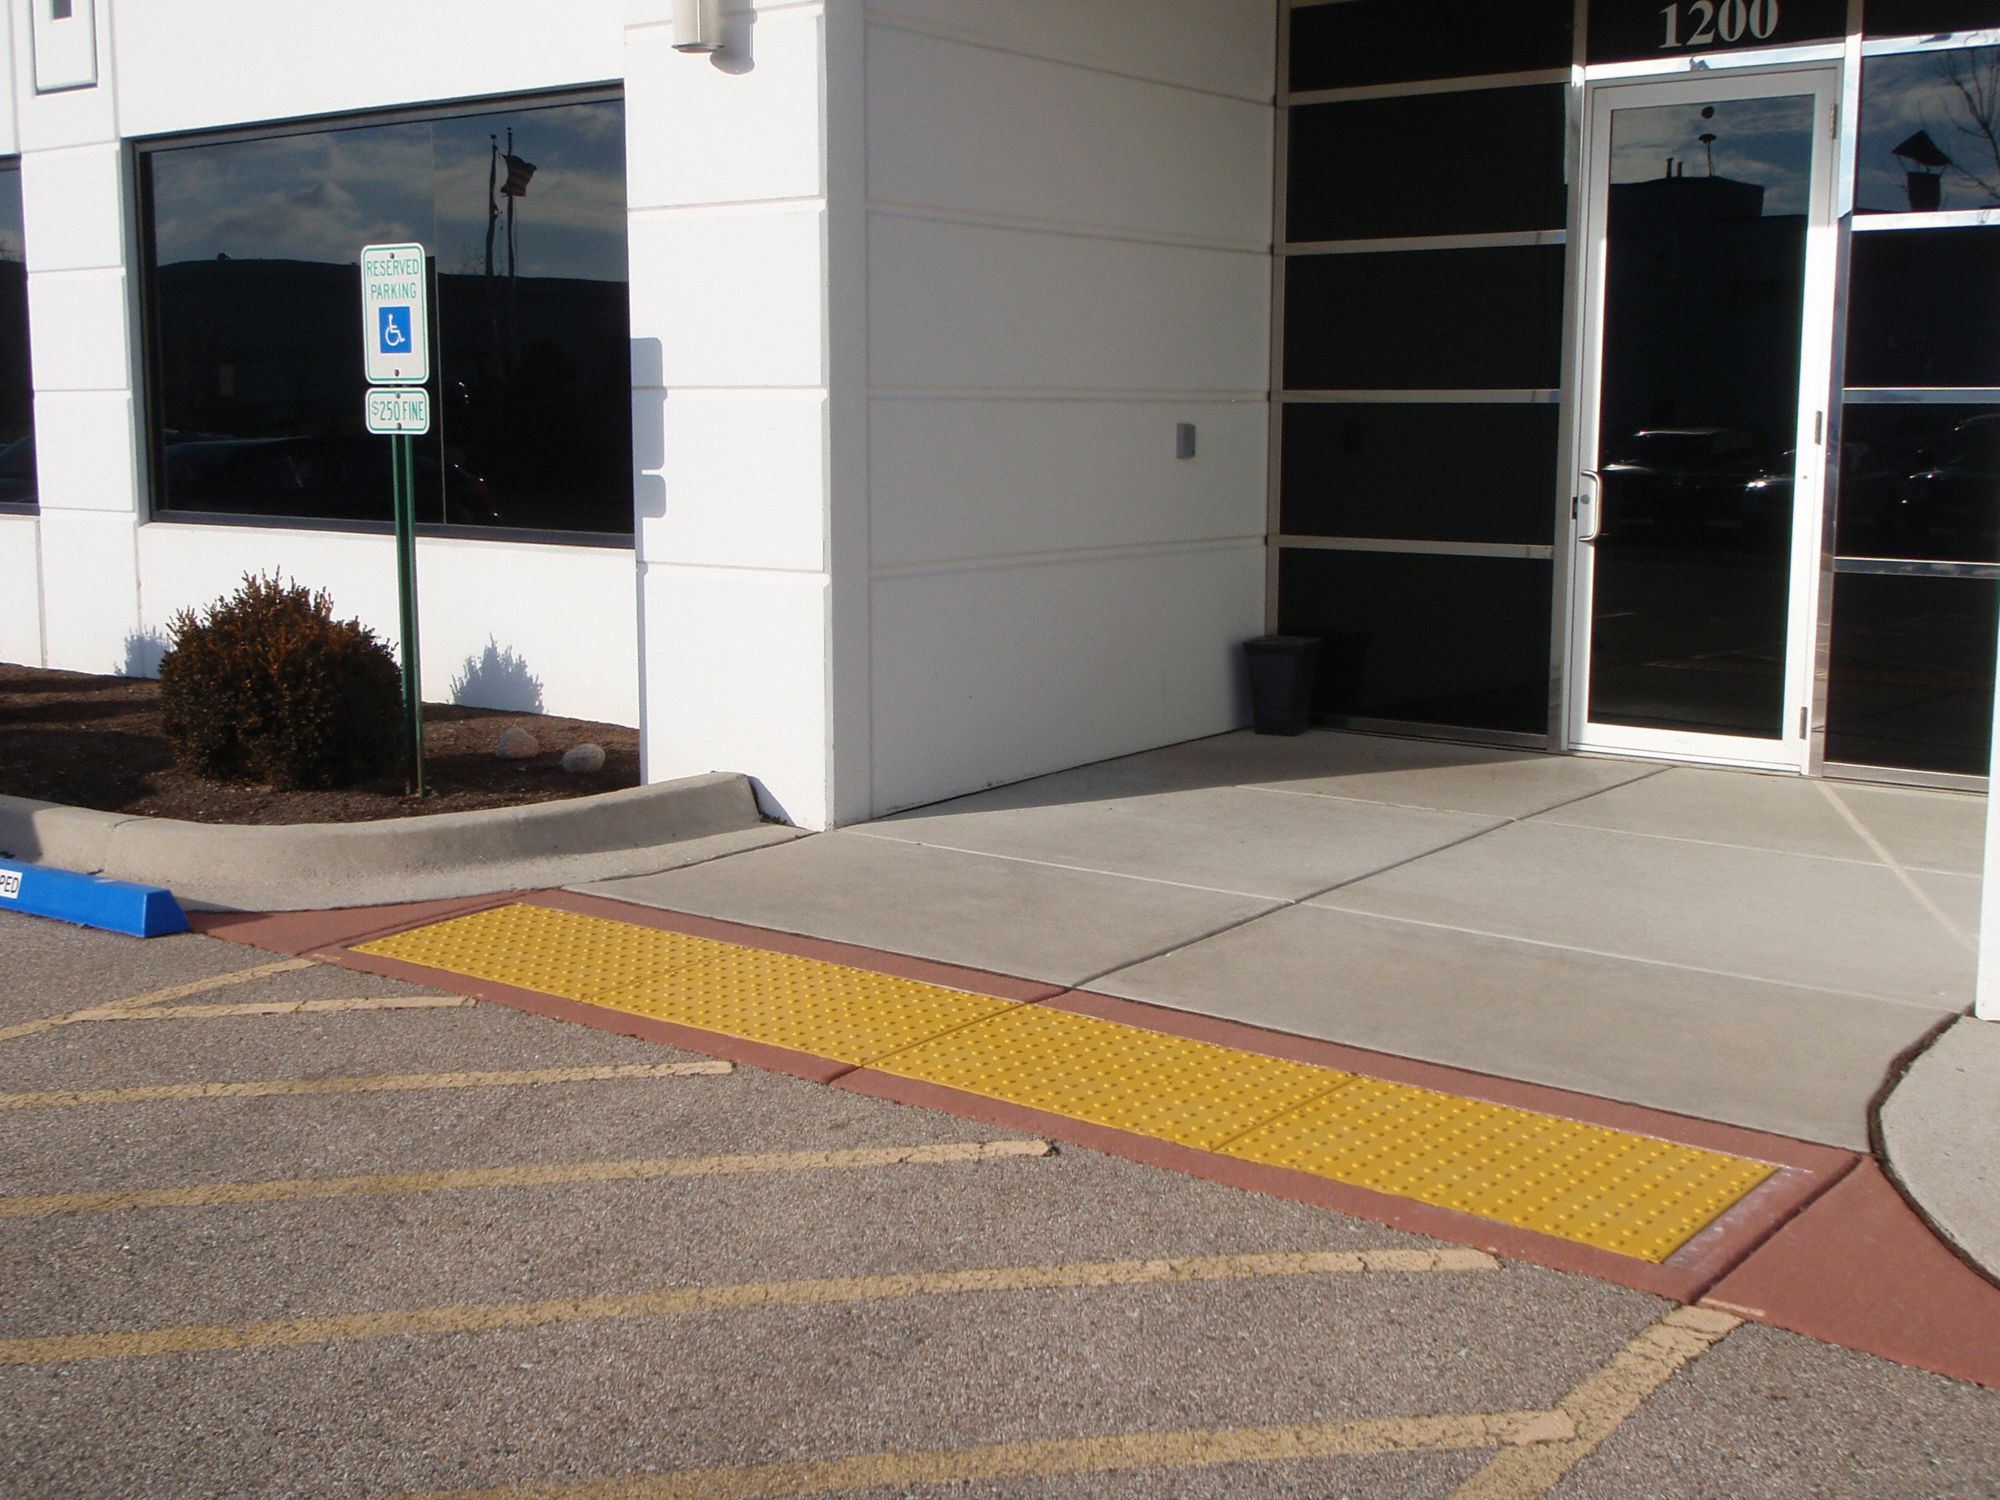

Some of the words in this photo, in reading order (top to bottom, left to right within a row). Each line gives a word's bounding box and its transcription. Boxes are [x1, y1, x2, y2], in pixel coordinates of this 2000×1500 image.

[1659, 0, 1778, 48] 1200
[366, 259, 419, 277] RESERVED
[371, 283, 417, 300] PARKING
[371, 401, 400, 421] $250
[402, 401, 424, 421] FINE
